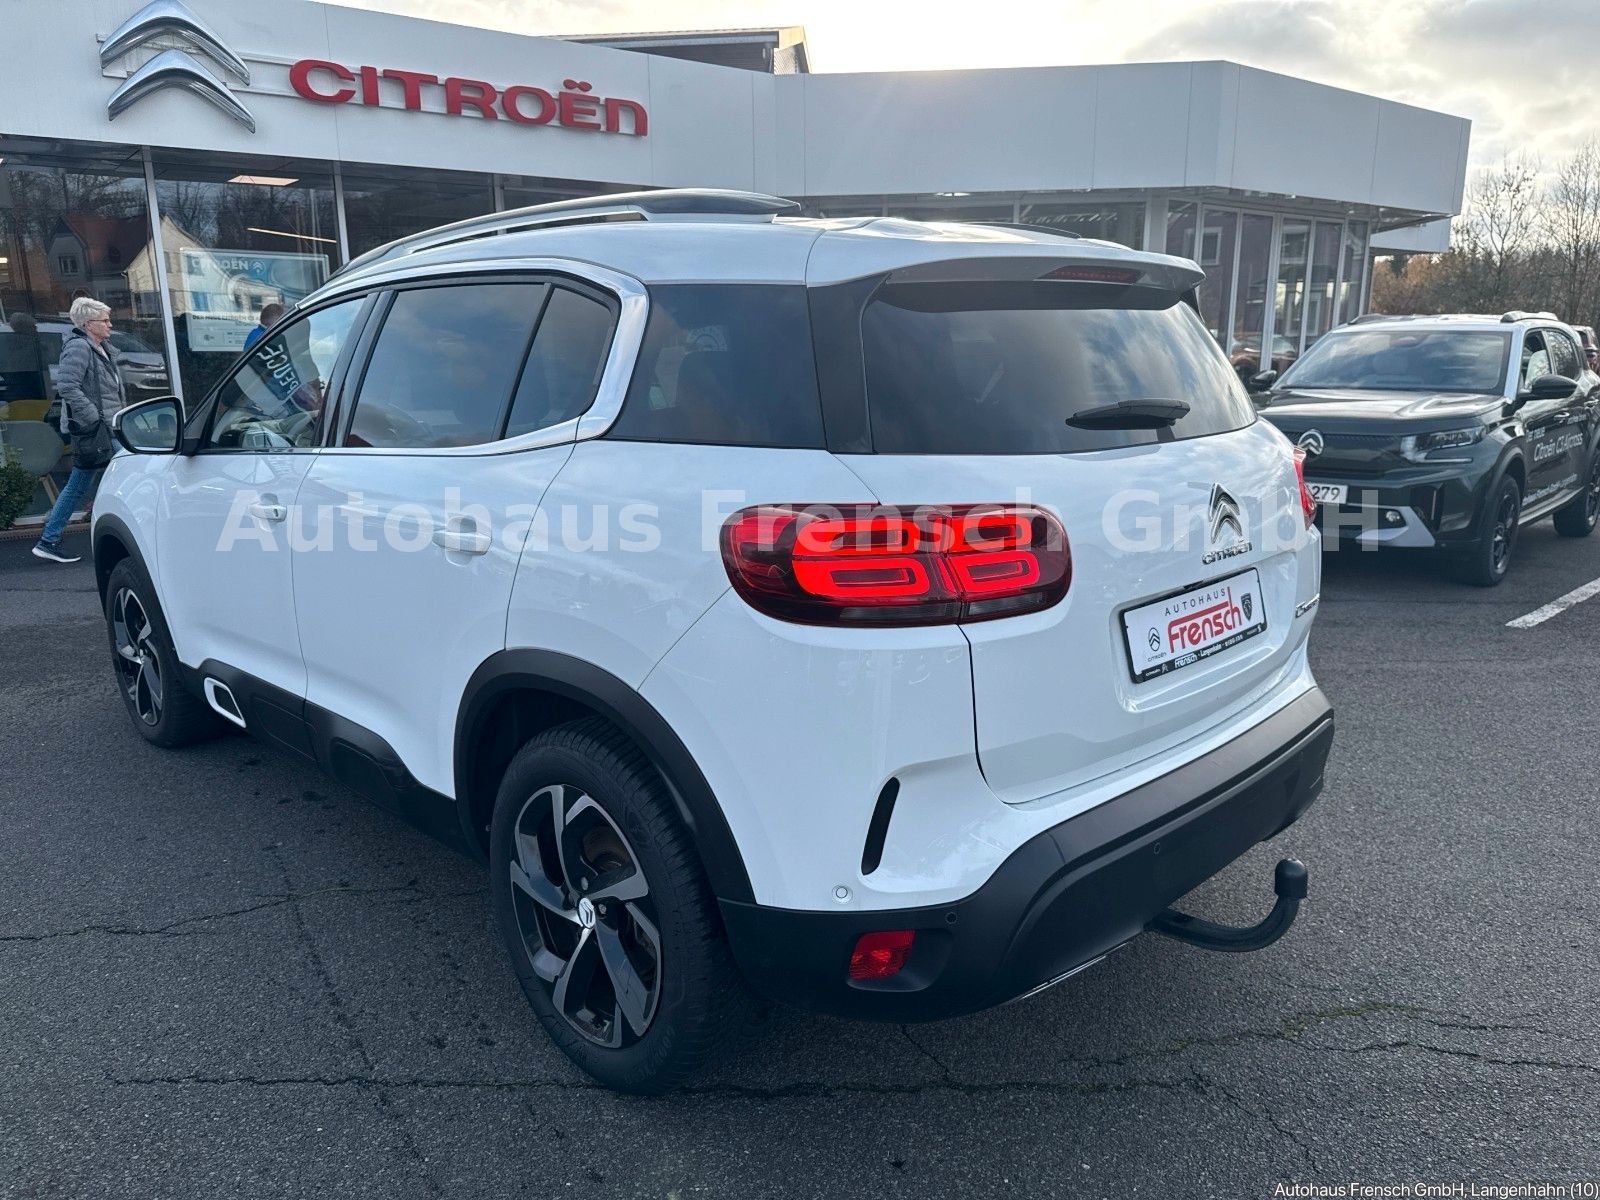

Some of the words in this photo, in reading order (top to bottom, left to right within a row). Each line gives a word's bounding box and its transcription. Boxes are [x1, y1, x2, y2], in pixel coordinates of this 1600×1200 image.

[289, 58, 648, 137] CITROËN
[1312, 486, 1340, 500] 279
[1165, 588, 1225, 616] AUTOHAUS
[1168, 586, 1242, 653] Frensch
